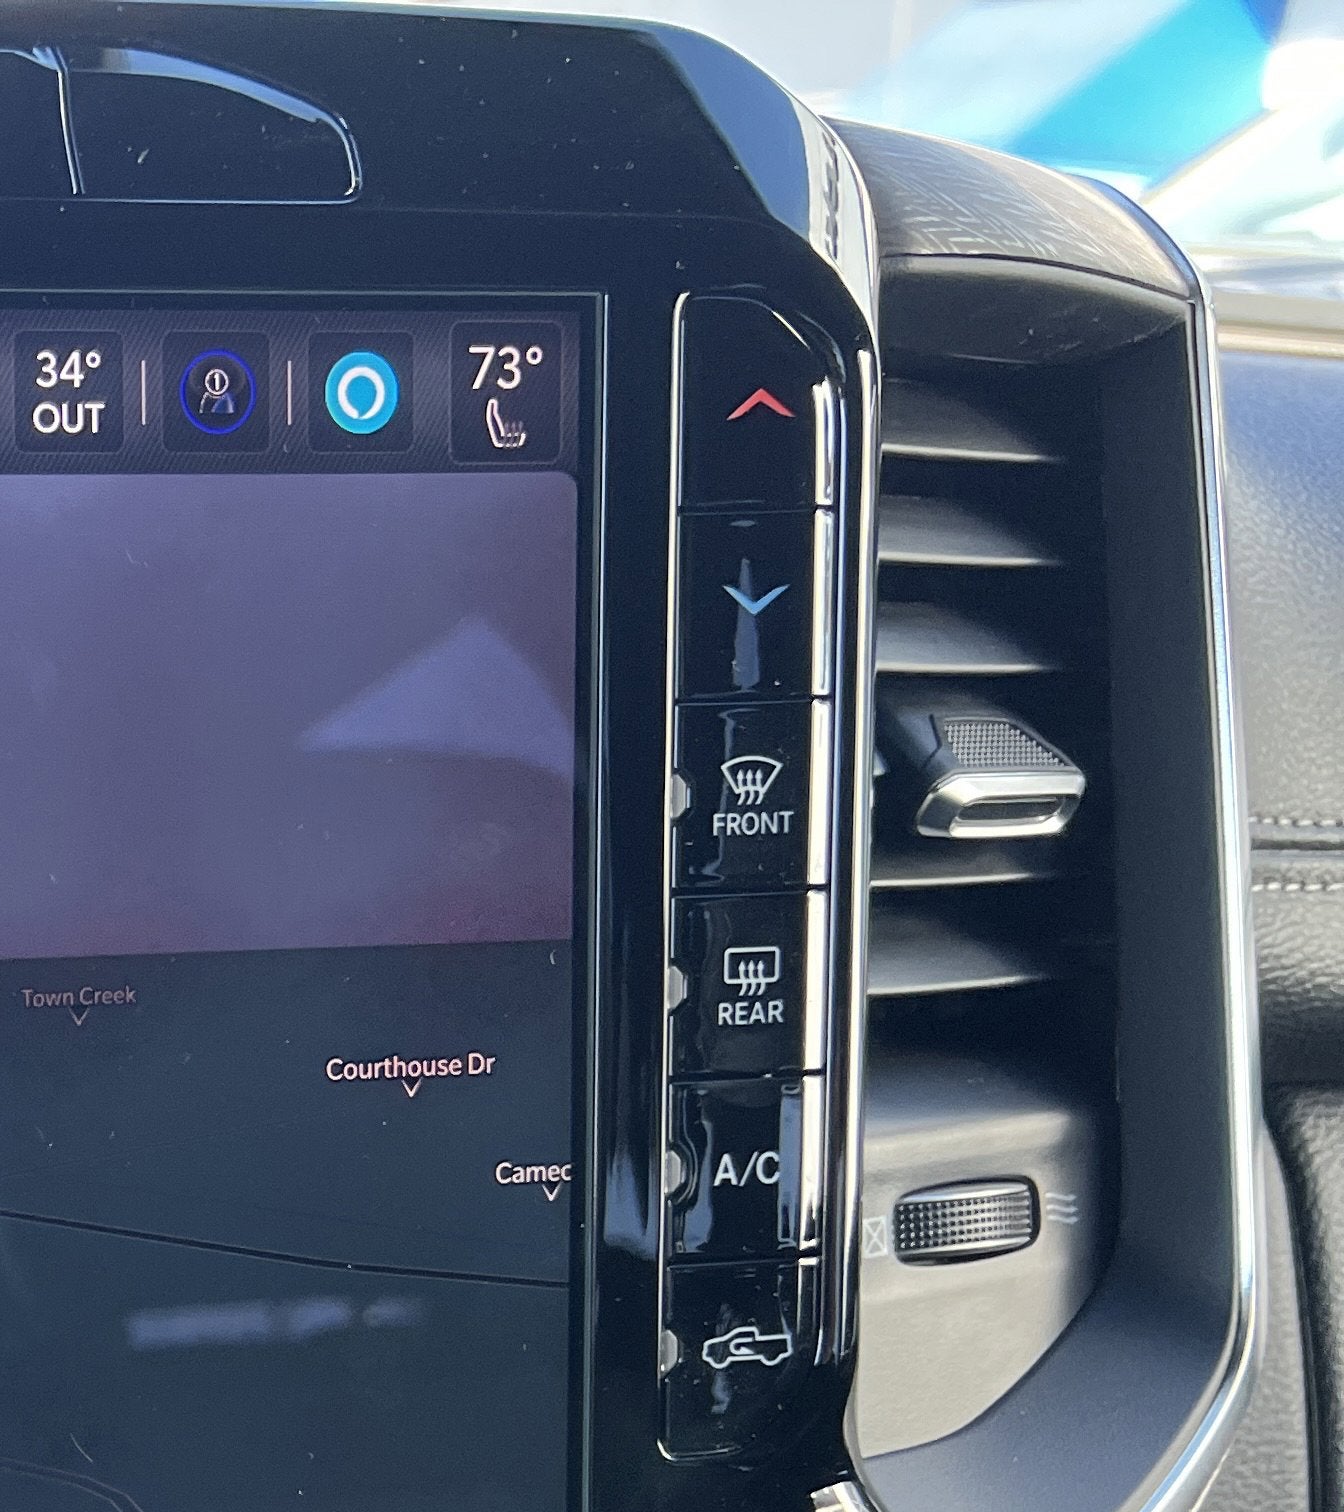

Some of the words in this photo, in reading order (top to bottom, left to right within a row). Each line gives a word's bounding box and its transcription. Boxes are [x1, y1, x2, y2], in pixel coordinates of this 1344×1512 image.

[35, 349, 102, 388] 34°
[467, 344, 544, 390] 73°
[32, 402, 105, 434] OUT
[712, 811, 794, 837] FRONT
[22, 987, 75, 1009] Town
[79, 984, 137, 1006] Creek
[717, 999, 784, 1026] REAR
[325, 1054, 462, 1082] Courthouse
[467, 1052, 497, 1077] Dr
[713, 1150, 781, 1187] A/C
